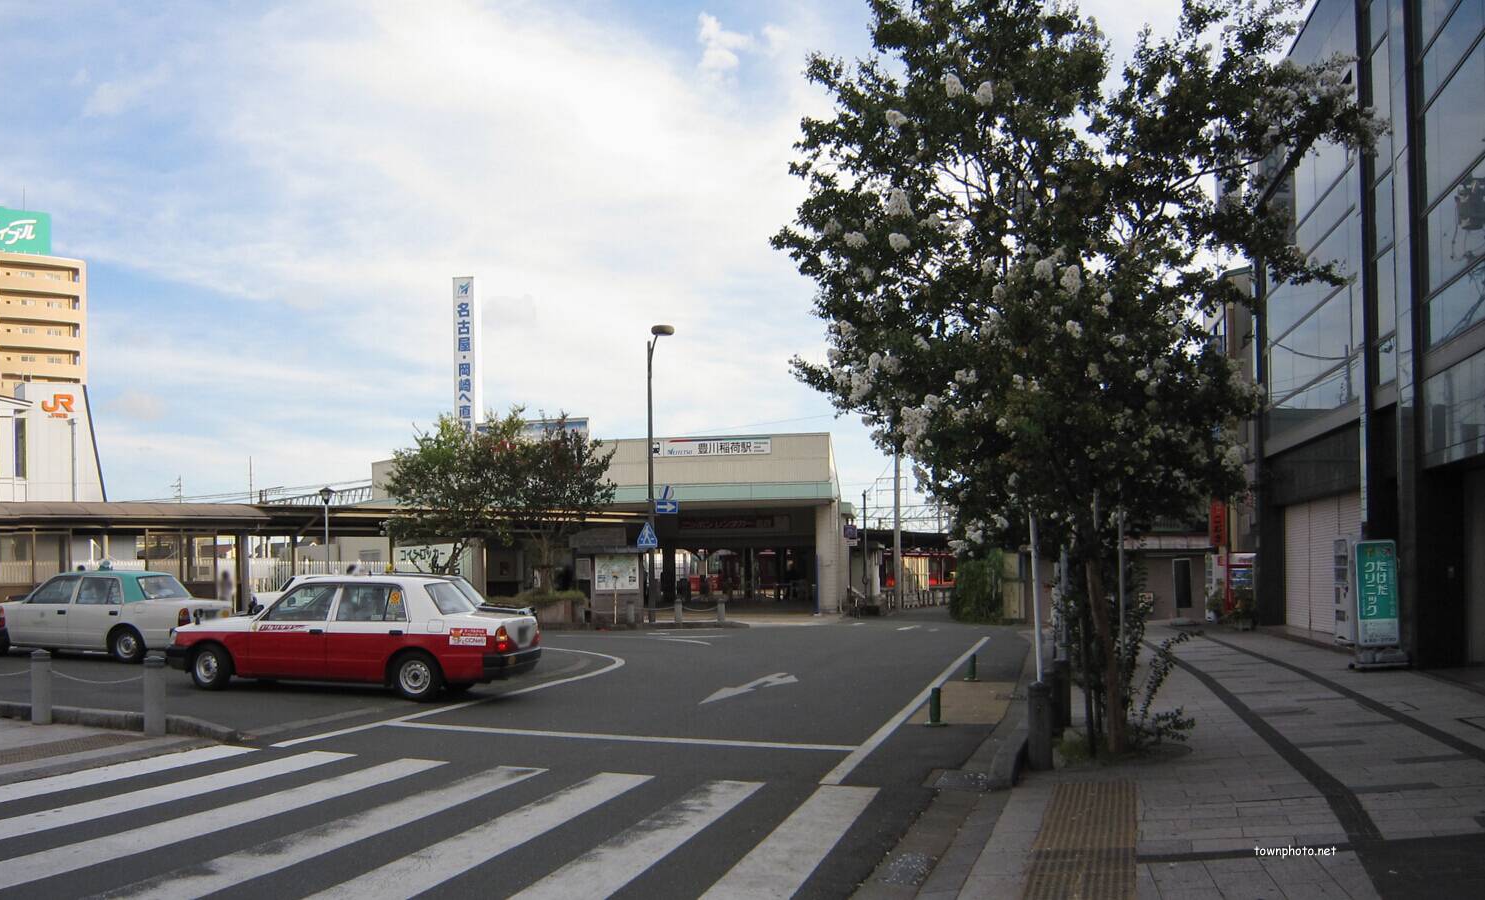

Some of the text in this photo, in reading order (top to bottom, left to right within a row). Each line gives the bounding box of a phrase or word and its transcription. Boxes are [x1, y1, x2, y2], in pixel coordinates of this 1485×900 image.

[42, 394, 73, 412] JR
[697, 441, 752, 455] 豊川稲荷駅
[1364, 562, 1377, 616] クリニック
[1376, 561, 1388, 595] たけだ
